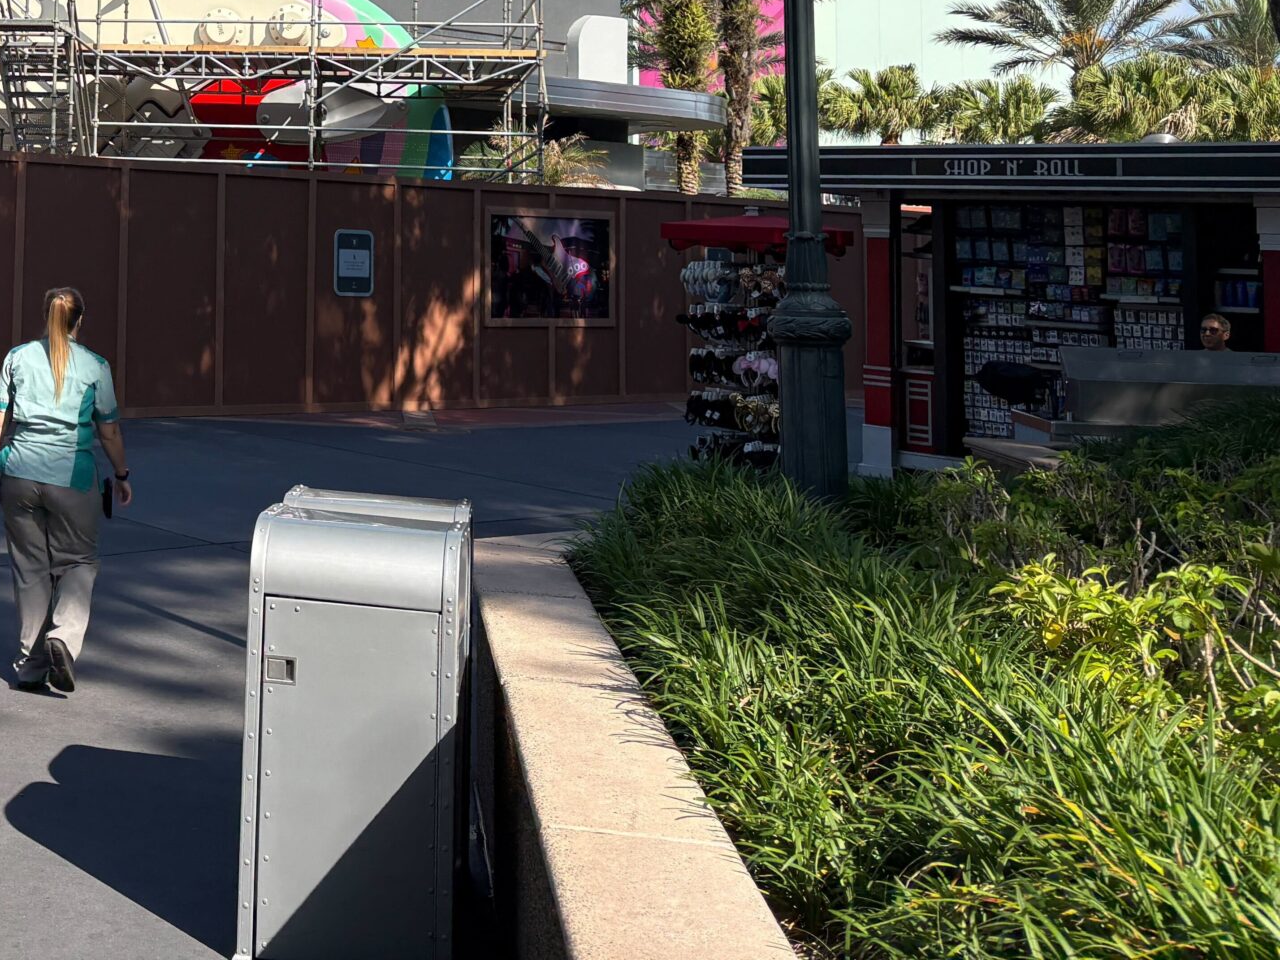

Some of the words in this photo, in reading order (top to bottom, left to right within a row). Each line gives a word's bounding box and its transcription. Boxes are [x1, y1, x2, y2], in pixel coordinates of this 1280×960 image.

[943, 159, 991, 176] SHOP
[1000, 159, 1023, 176] 'N'
[1033, 159, 1085, 176] ROLL
